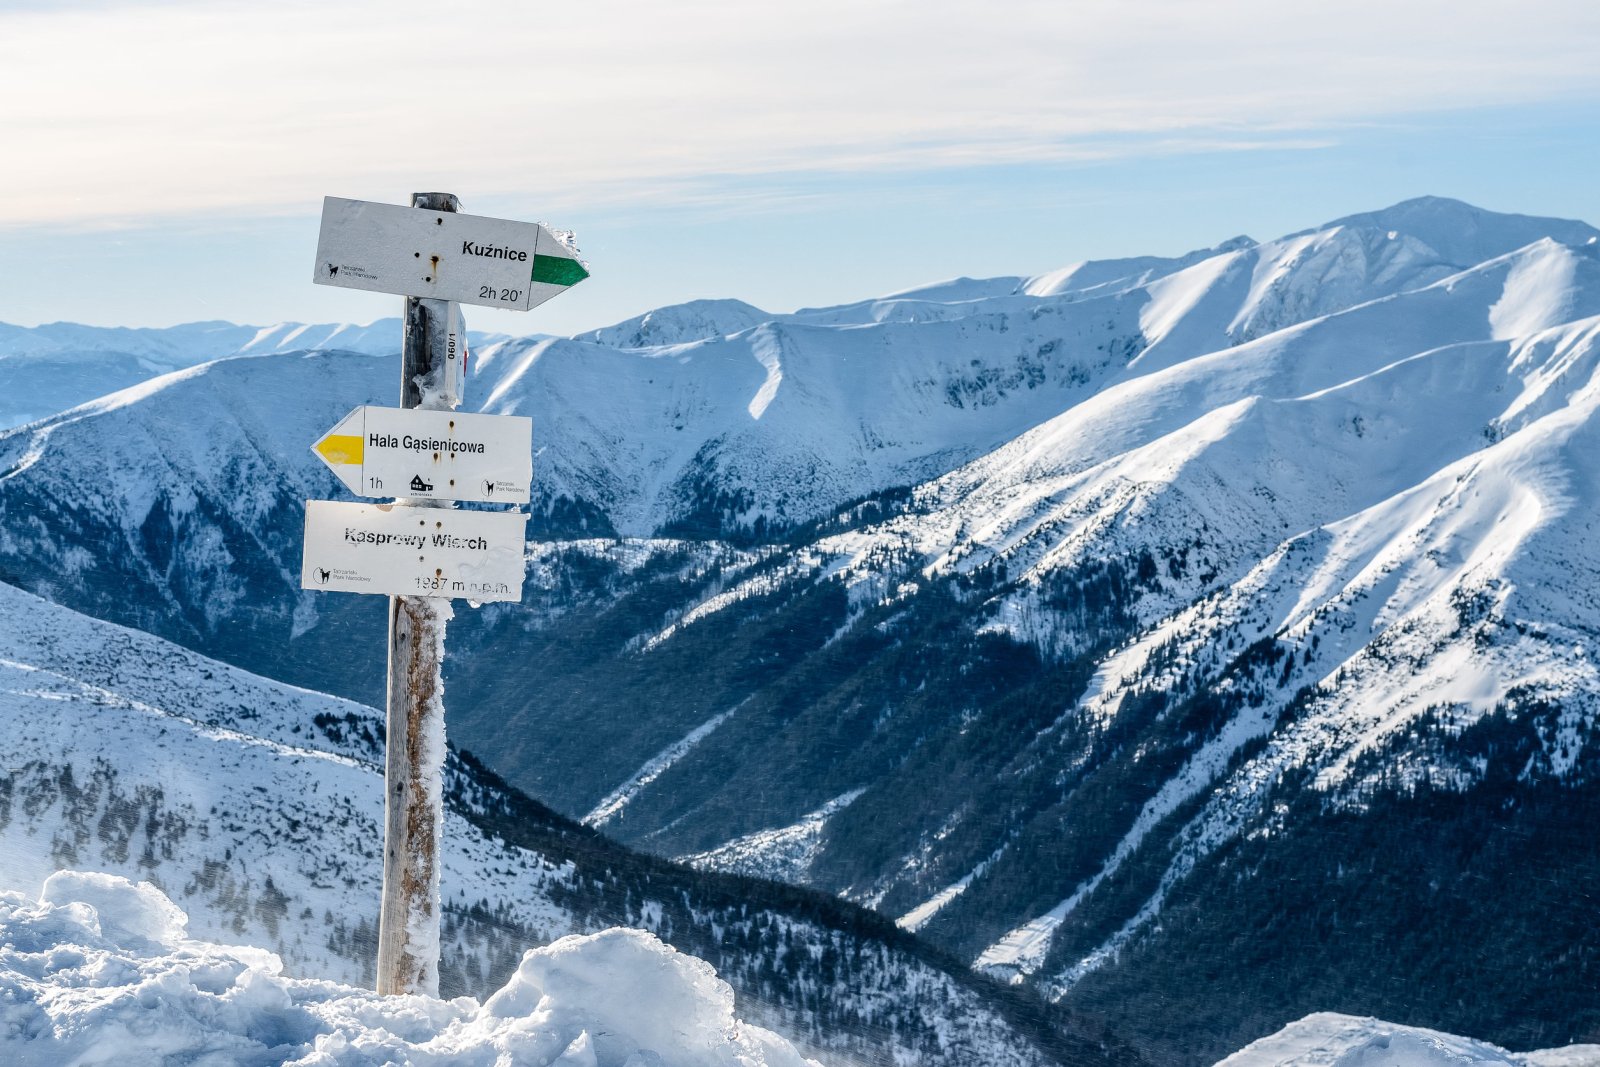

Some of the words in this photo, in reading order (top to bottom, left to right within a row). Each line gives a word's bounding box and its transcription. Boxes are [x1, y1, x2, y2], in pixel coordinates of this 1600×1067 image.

[462, 241, 527, 262] Kuźnice
[479, 285, 497, 300] 2h
[500, 288, 523, 302] 20'
[447, 333, 456, 360] 060/1
[369, 433, 398, 448] Hala
[402, 435, 485, 453] Gąsienicowa
[369, 477, 383, 490] 1h
[345, 527, 426, 550] Kasprowy
[415, 577, 448, 591] 1987
[452, 581, 465, 592] m
